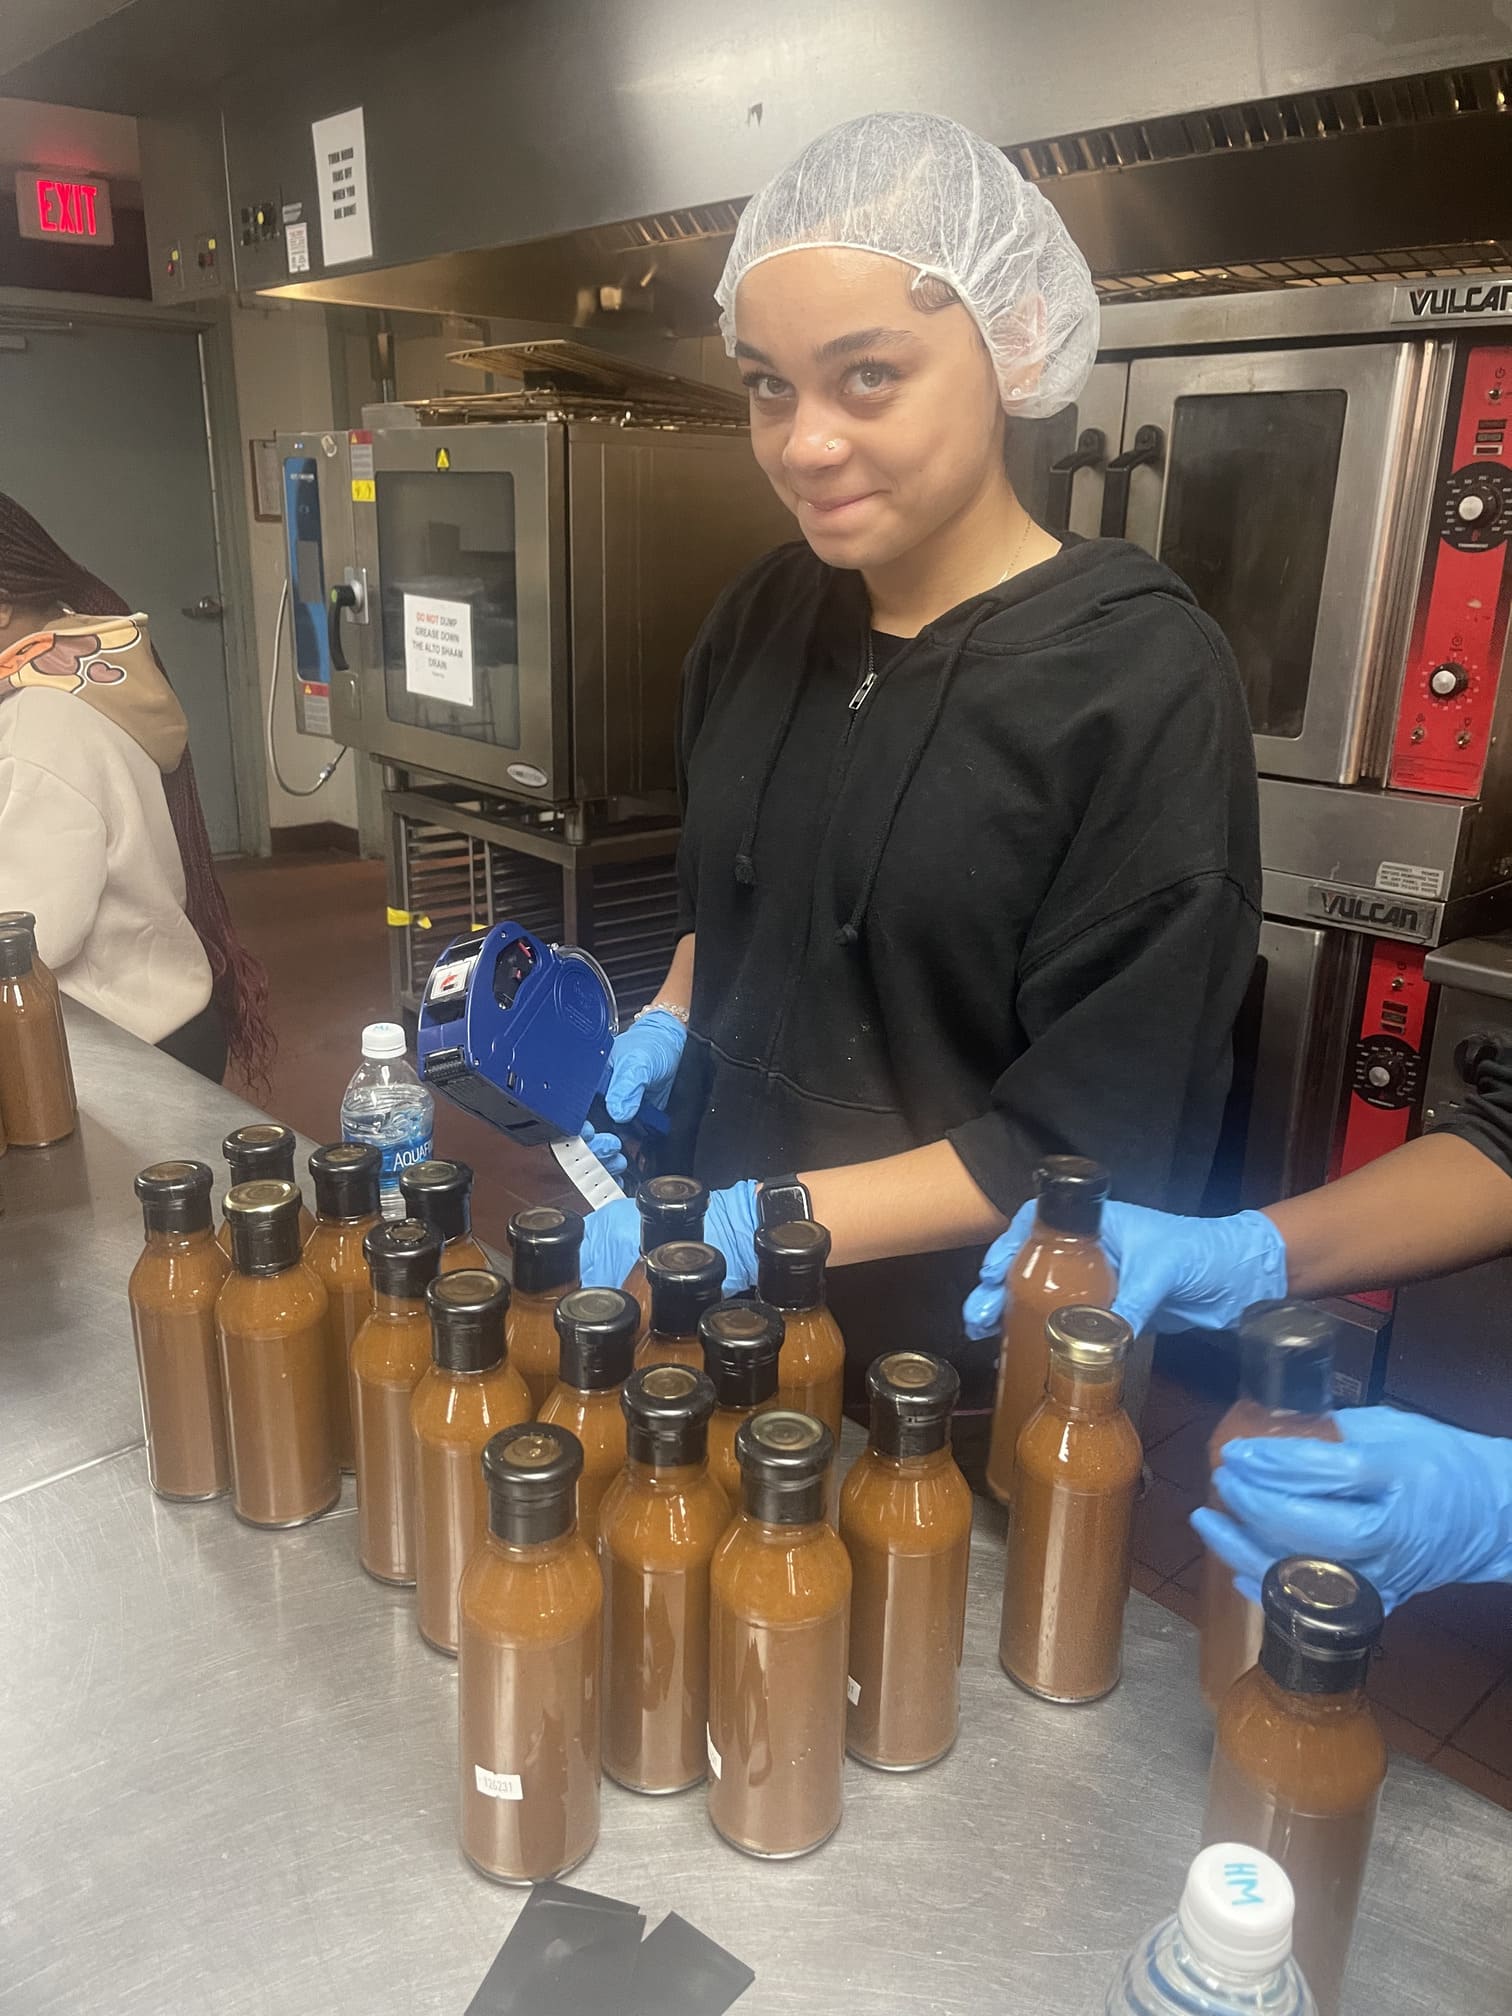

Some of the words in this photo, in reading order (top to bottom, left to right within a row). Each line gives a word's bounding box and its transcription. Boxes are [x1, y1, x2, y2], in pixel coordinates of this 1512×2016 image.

[36, 180, 97, 236] EXIT
[416, 611, 425, 622] DO
[426, 613, 439, 625] NOT
[440, 616, 458, 628] DUMP
[415, 626, 440, 640] GREASE
[440, 630, 460, 643] DOWN
[412, 640, 424, 651] THE
[425, 642, 440, 655] ALTO
[441, 646, 464, 658] SHAAM
[428, 658, 447, 670] DRAIN
[1321, 892, 1418, 932] VULCAN
[1223, 1863, 1265, 1906] HM
